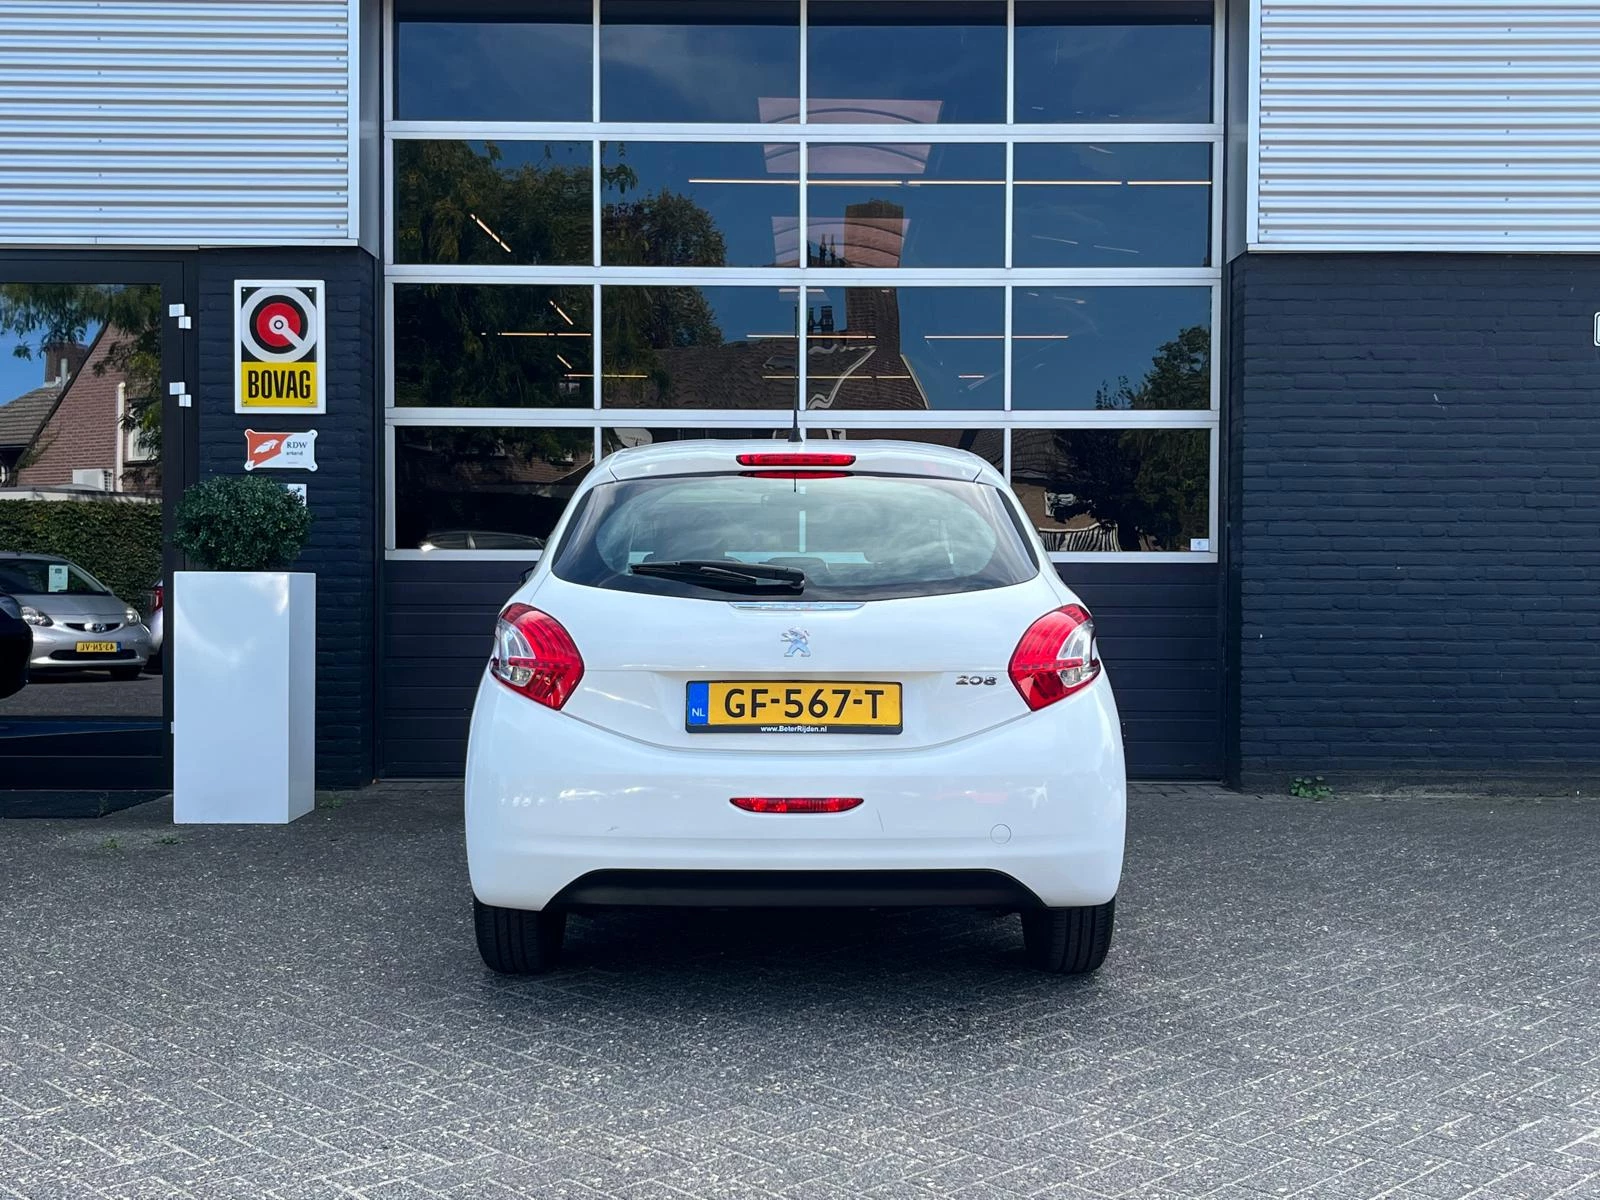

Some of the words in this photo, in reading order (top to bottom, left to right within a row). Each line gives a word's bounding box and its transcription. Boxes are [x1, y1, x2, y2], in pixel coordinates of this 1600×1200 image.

[248, 370, 311, 399] BOVAG
[286, 441, 308, 449] RDW
[955, 675, 998, 686] 208
[724, 688, 884, 719] GF-567-T
[691, 708, 706, 717] NL
[760, 725, 828, 734] www.BeterRijden.nl
